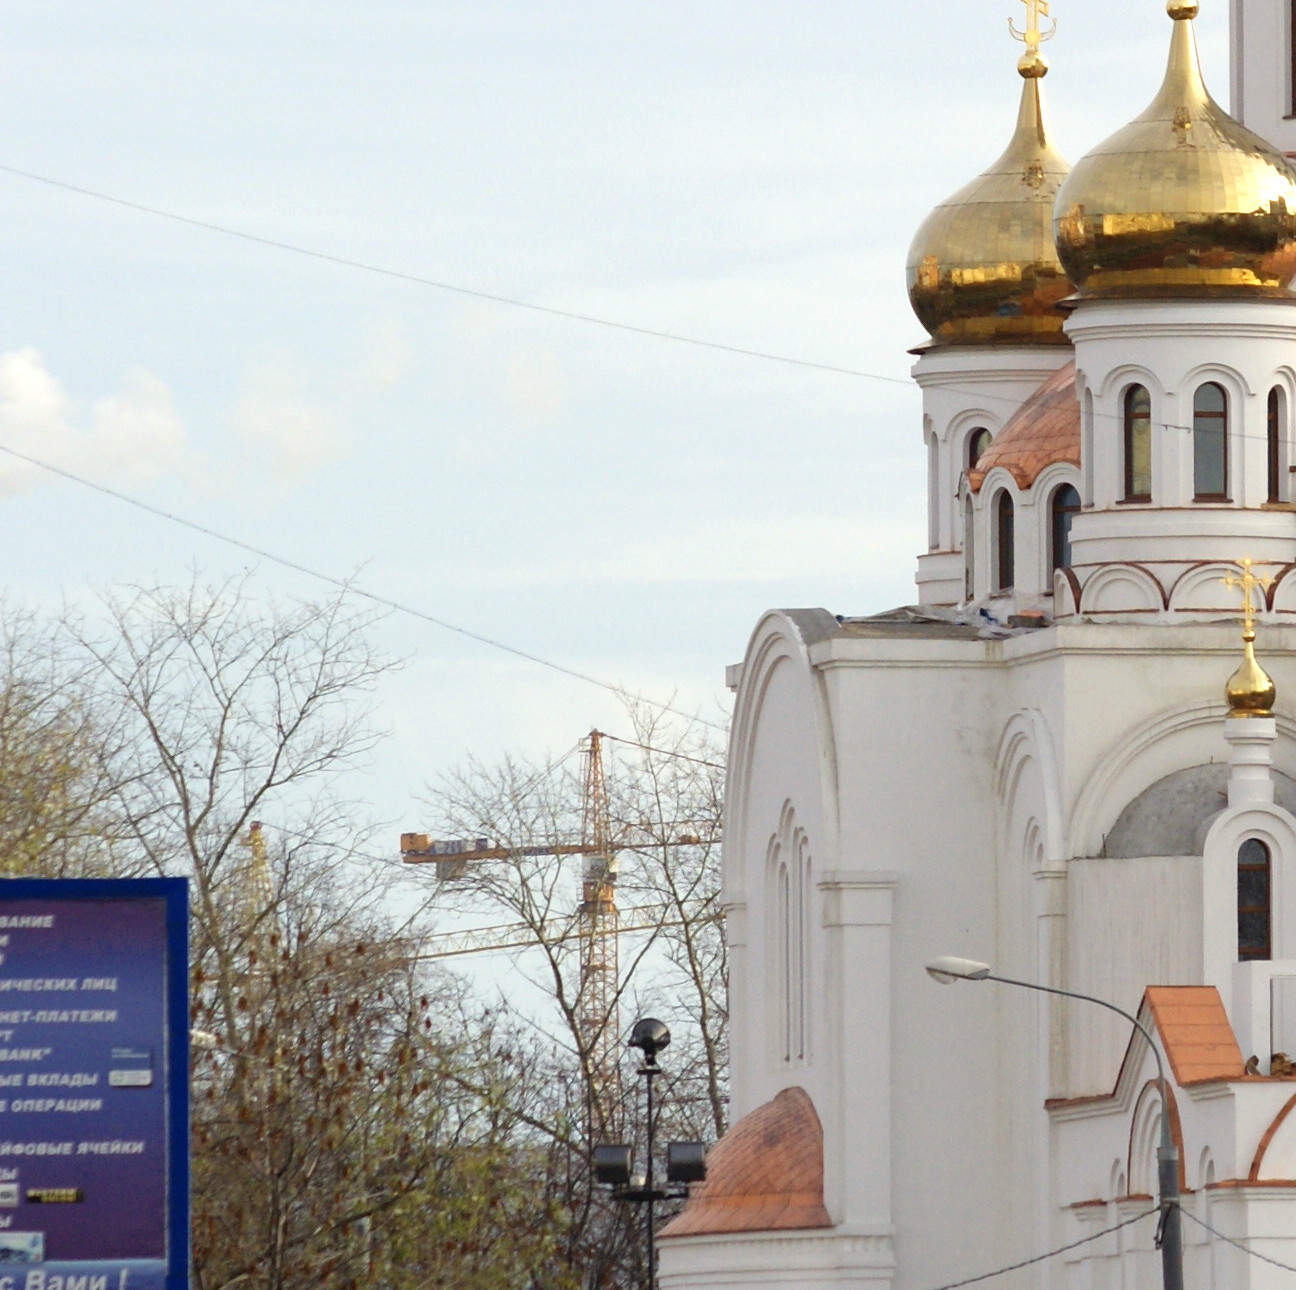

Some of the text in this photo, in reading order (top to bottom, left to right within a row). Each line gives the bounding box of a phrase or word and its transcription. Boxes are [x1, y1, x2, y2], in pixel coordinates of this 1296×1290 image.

[81, 977, 117, 992] ЛИЦ
[27, 1073, 98, 1088] ВКЛАДЫ
[11, 1098, 102, 1113] ОПЕРАЦИИ
[76, 1139, 144, 1155] ЯЧЕЙКИ
